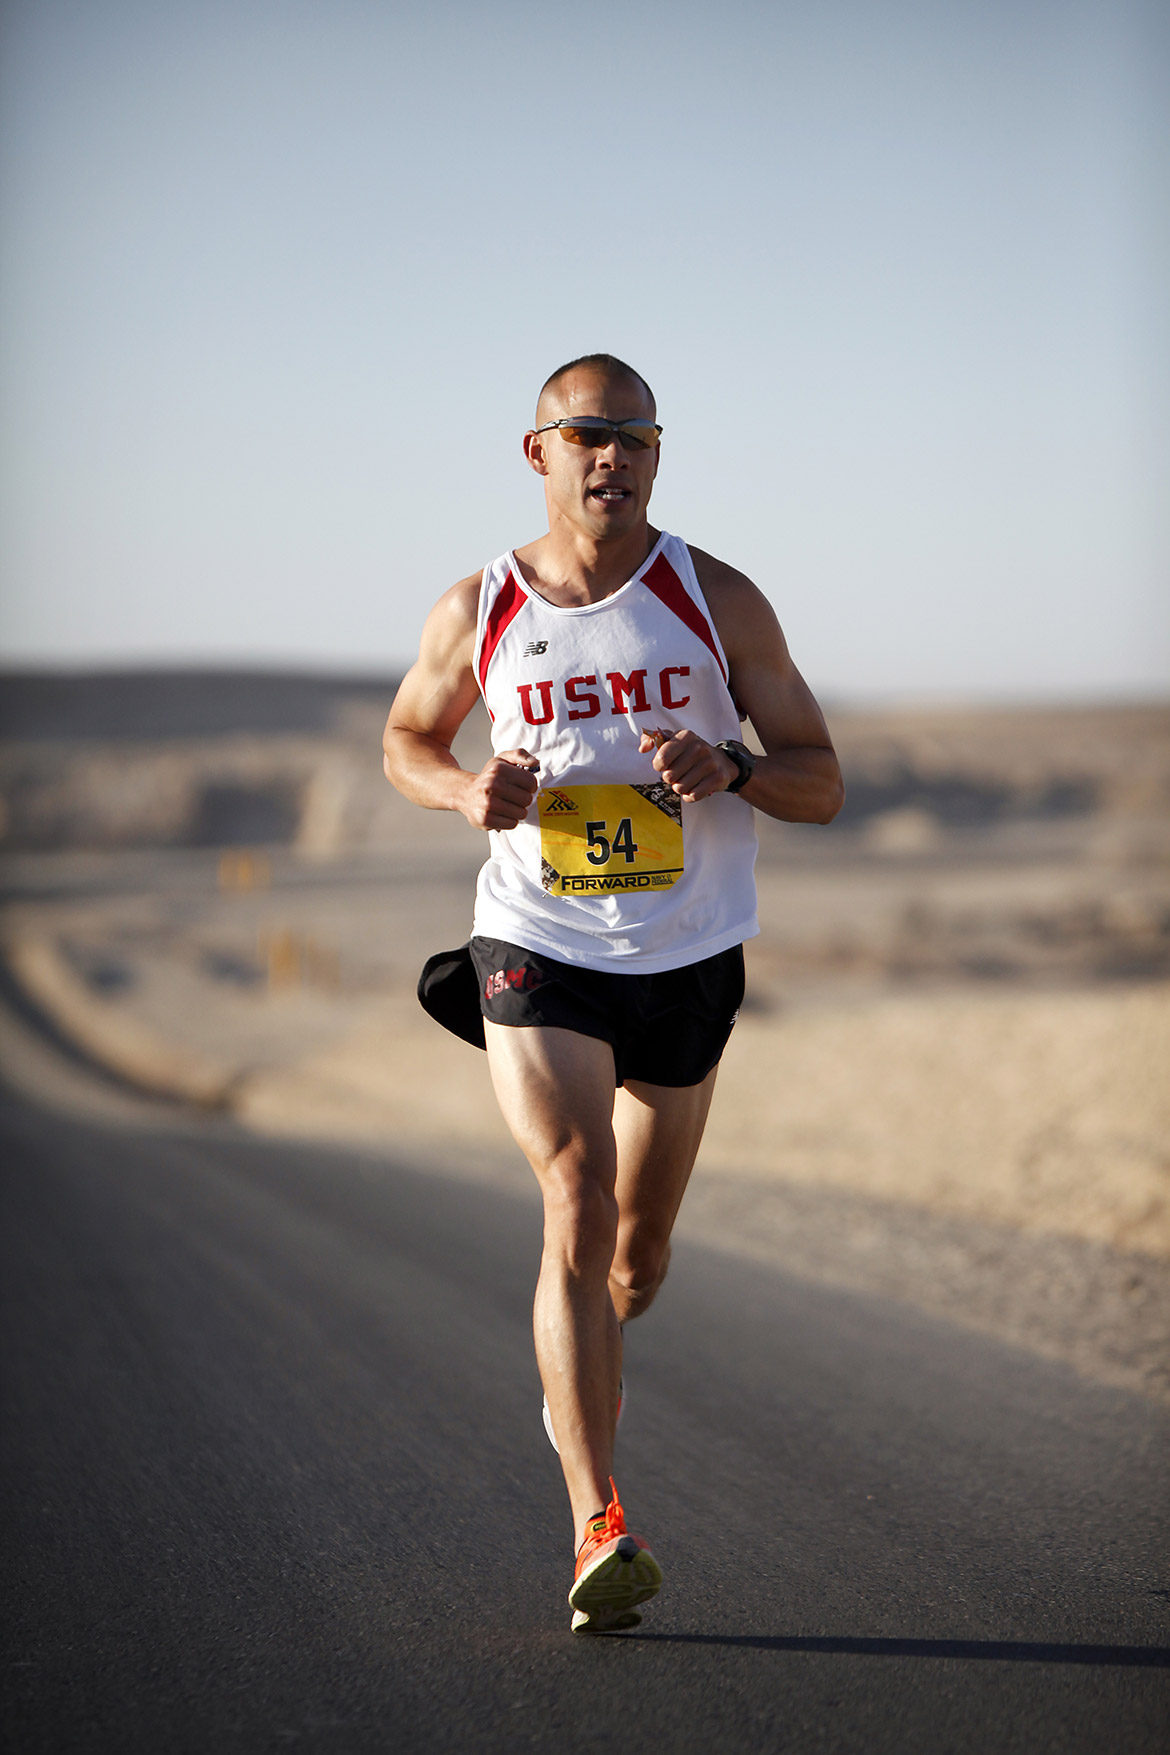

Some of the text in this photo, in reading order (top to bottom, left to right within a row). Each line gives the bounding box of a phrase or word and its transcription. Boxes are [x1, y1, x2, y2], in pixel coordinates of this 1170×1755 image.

[516, 666, 691, 725] USMC
[585, 818, 638, 866] 54
[561, 876, 650, 890] FORWARD
